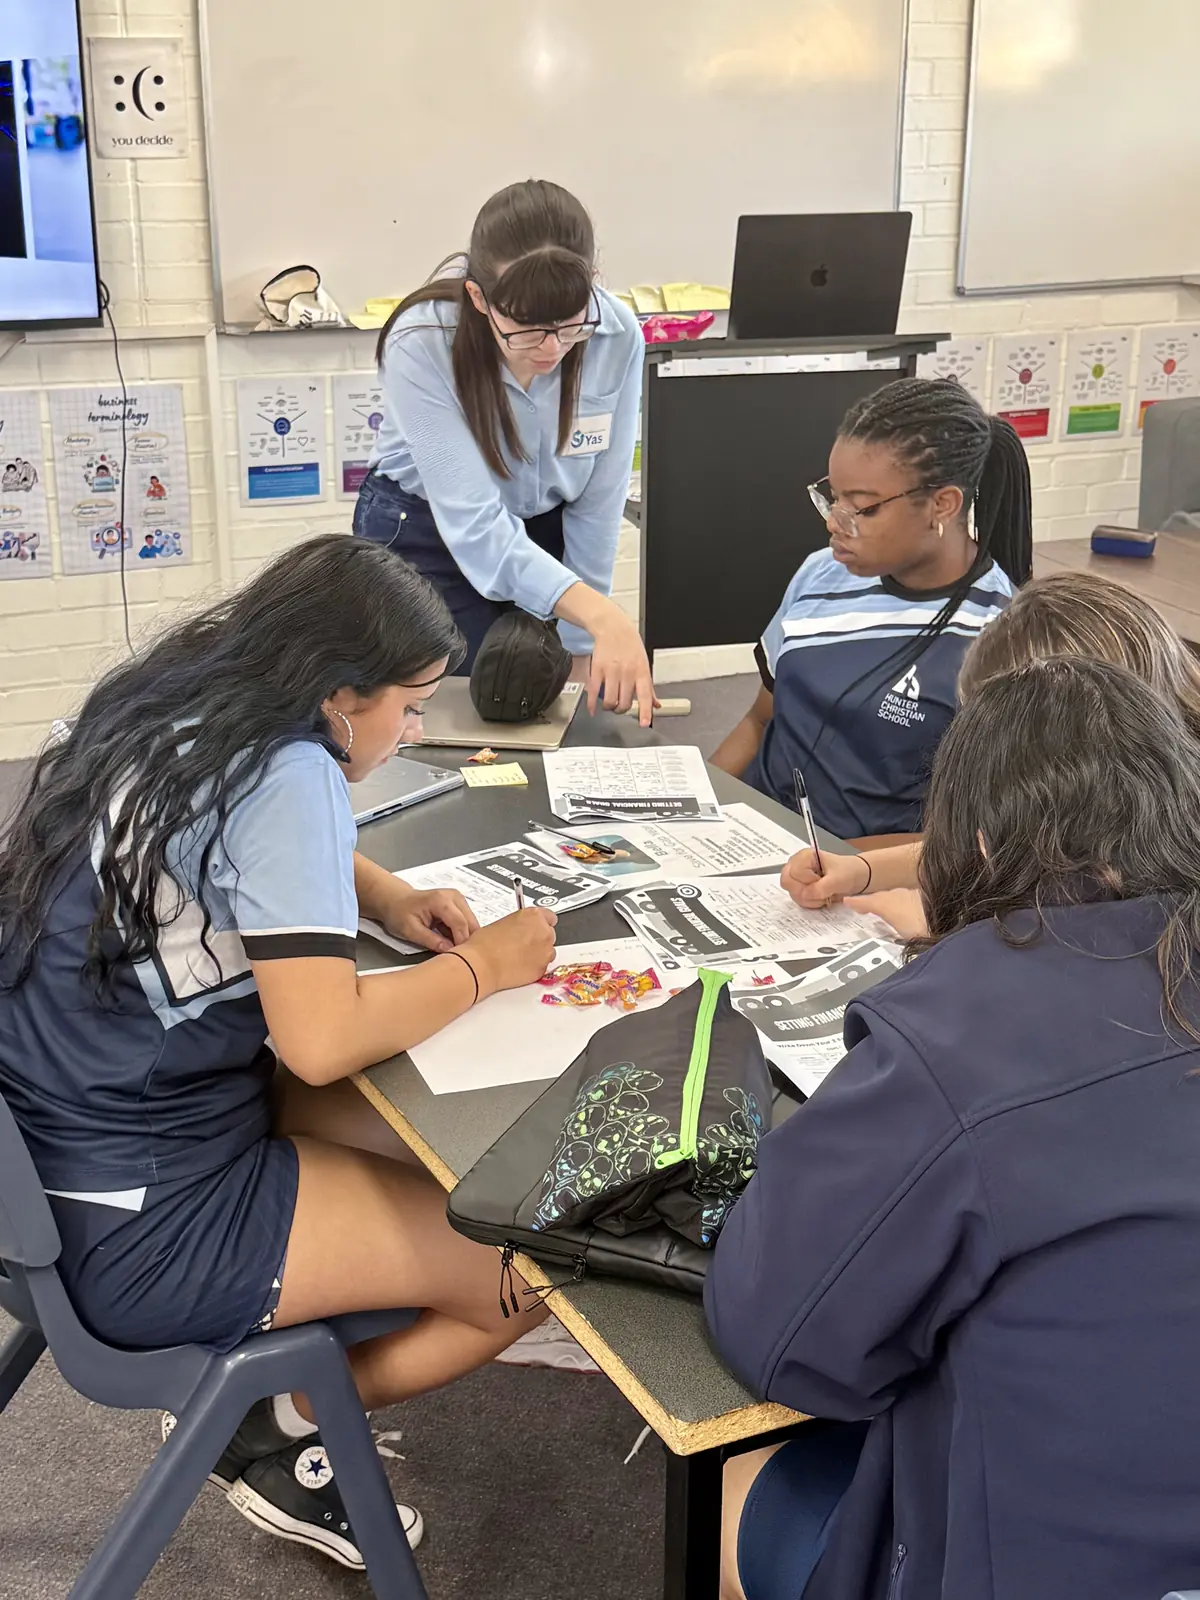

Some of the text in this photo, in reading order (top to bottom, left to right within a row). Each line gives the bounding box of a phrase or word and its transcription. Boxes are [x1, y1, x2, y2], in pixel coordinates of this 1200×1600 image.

[111, 135, 173, 148] you decide
[585, 434, 603, 446] Yas
[884, 693, 919, 711] HUNTER
[877, 709, 911, 728] SCHOOL
[880, 701, 926, 722] CHRISTIAN
[773, 1003, 848, 1031] SETTING FINANC
